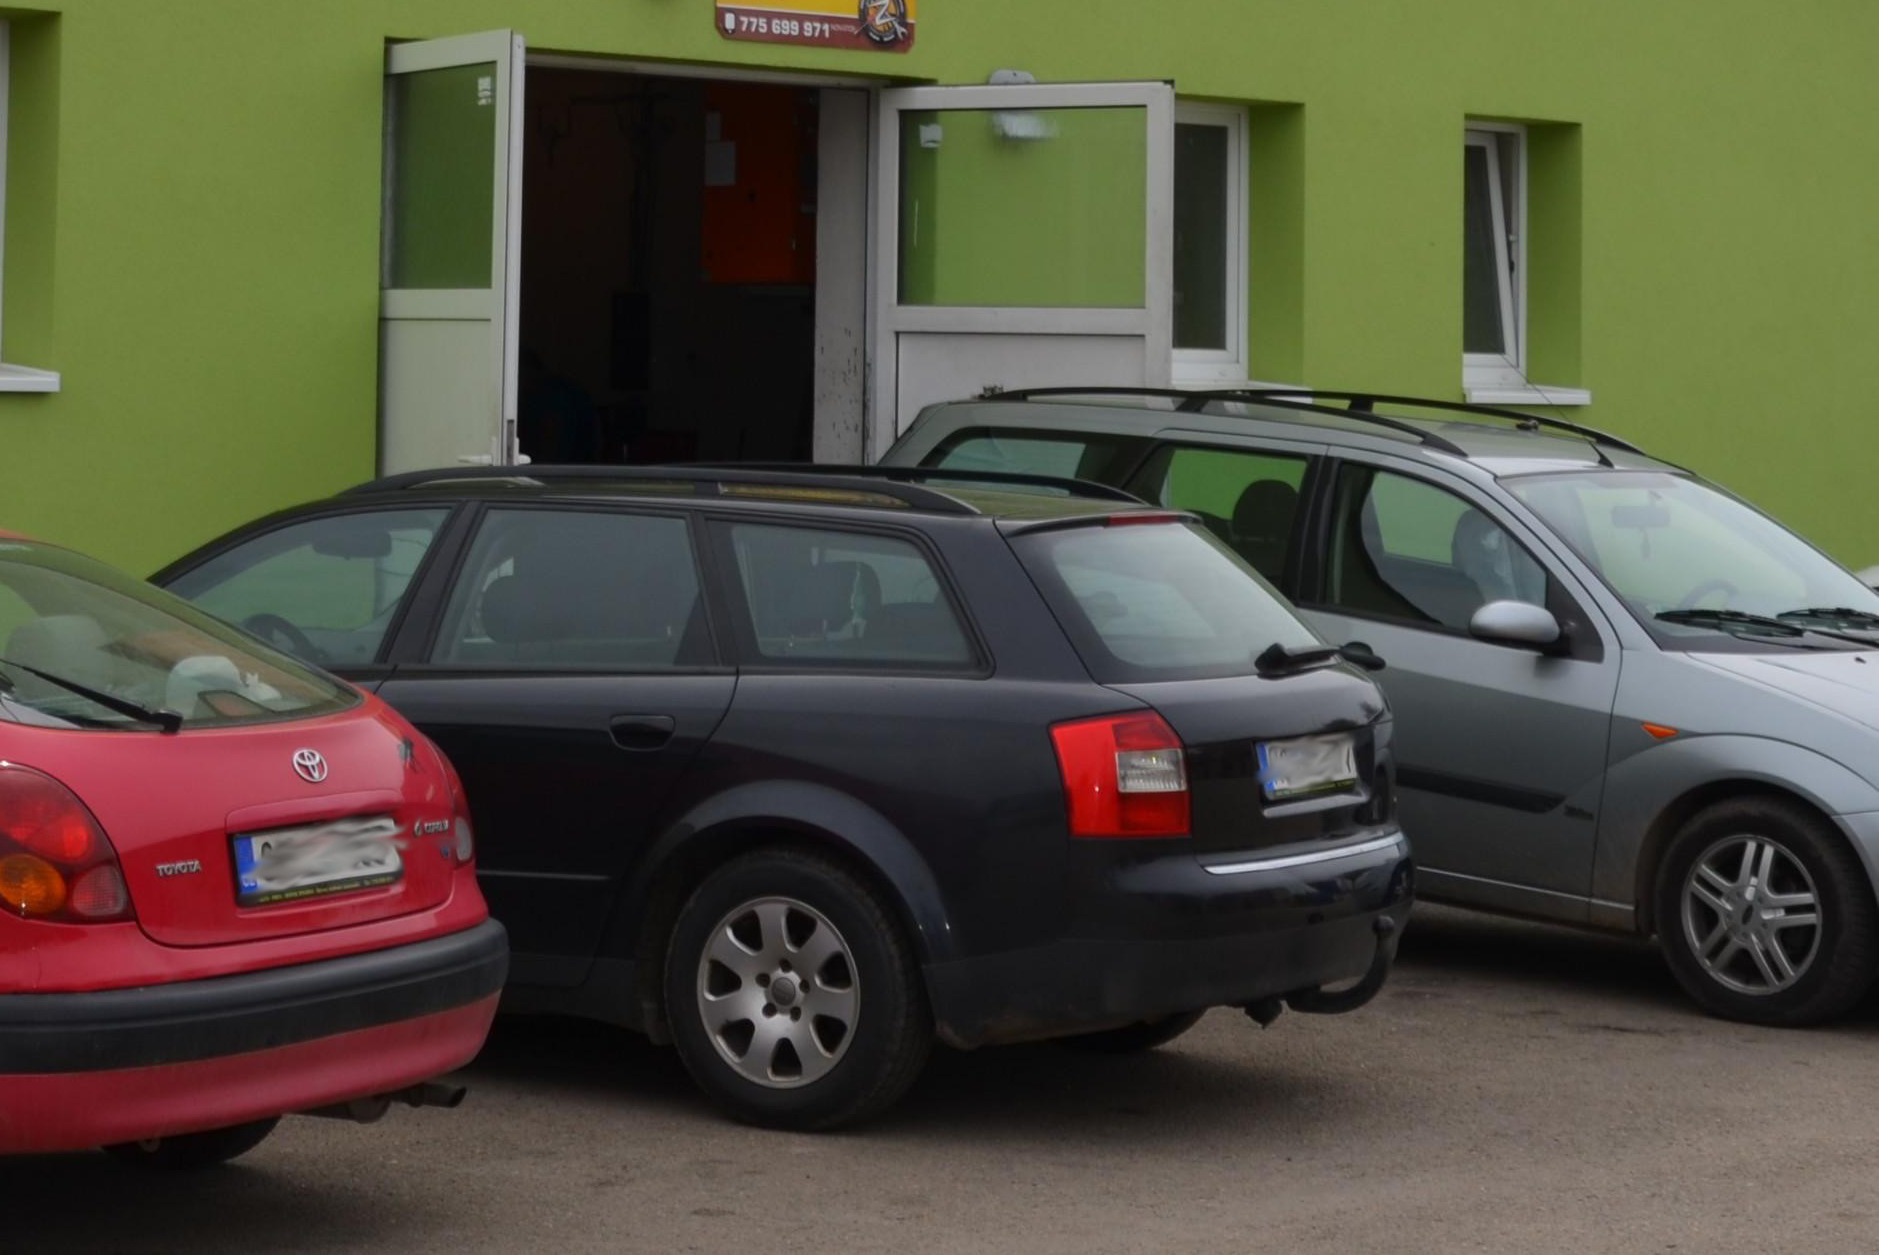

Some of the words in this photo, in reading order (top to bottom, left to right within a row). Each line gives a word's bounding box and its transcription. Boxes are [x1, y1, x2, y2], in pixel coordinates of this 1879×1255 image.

[740, 16, 767, 33] 775
[772, 19, 800, 36] 699
[803, 22, 830, 38] 971
[156, 860, 202, 876] TOYOTA
